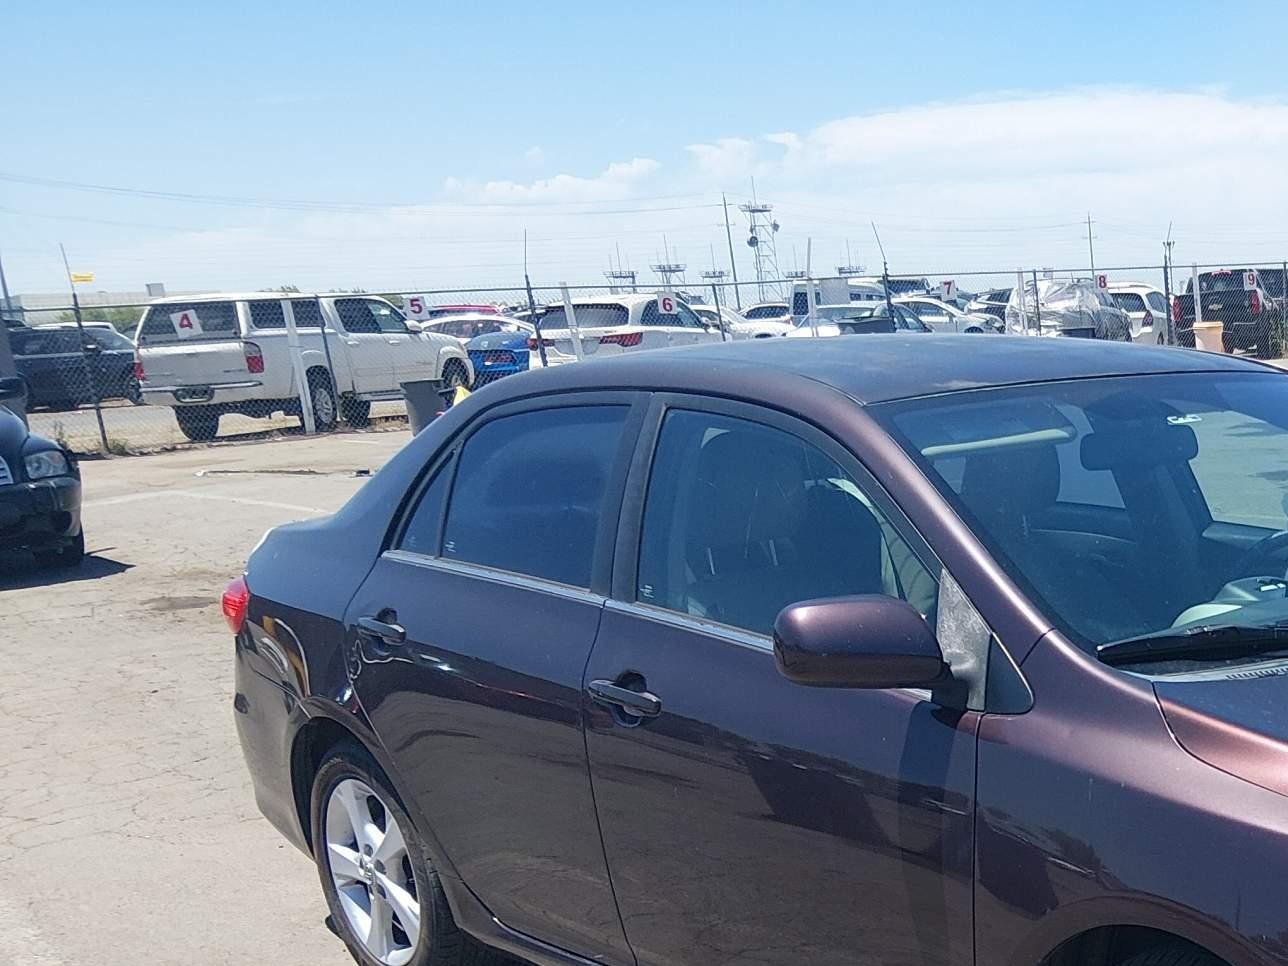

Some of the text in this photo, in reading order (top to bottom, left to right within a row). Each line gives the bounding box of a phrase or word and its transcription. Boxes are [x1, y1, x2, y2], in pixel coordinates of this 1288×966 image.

[1098, 275, 1107, 289] 8
[1247, 273, 1256, 286] 9
[943, 281, 952, 296] 7
[409, 298, 423, 314] 5
[662, 297, 673, 312] 6
[178, 313, 194, 330] 4
